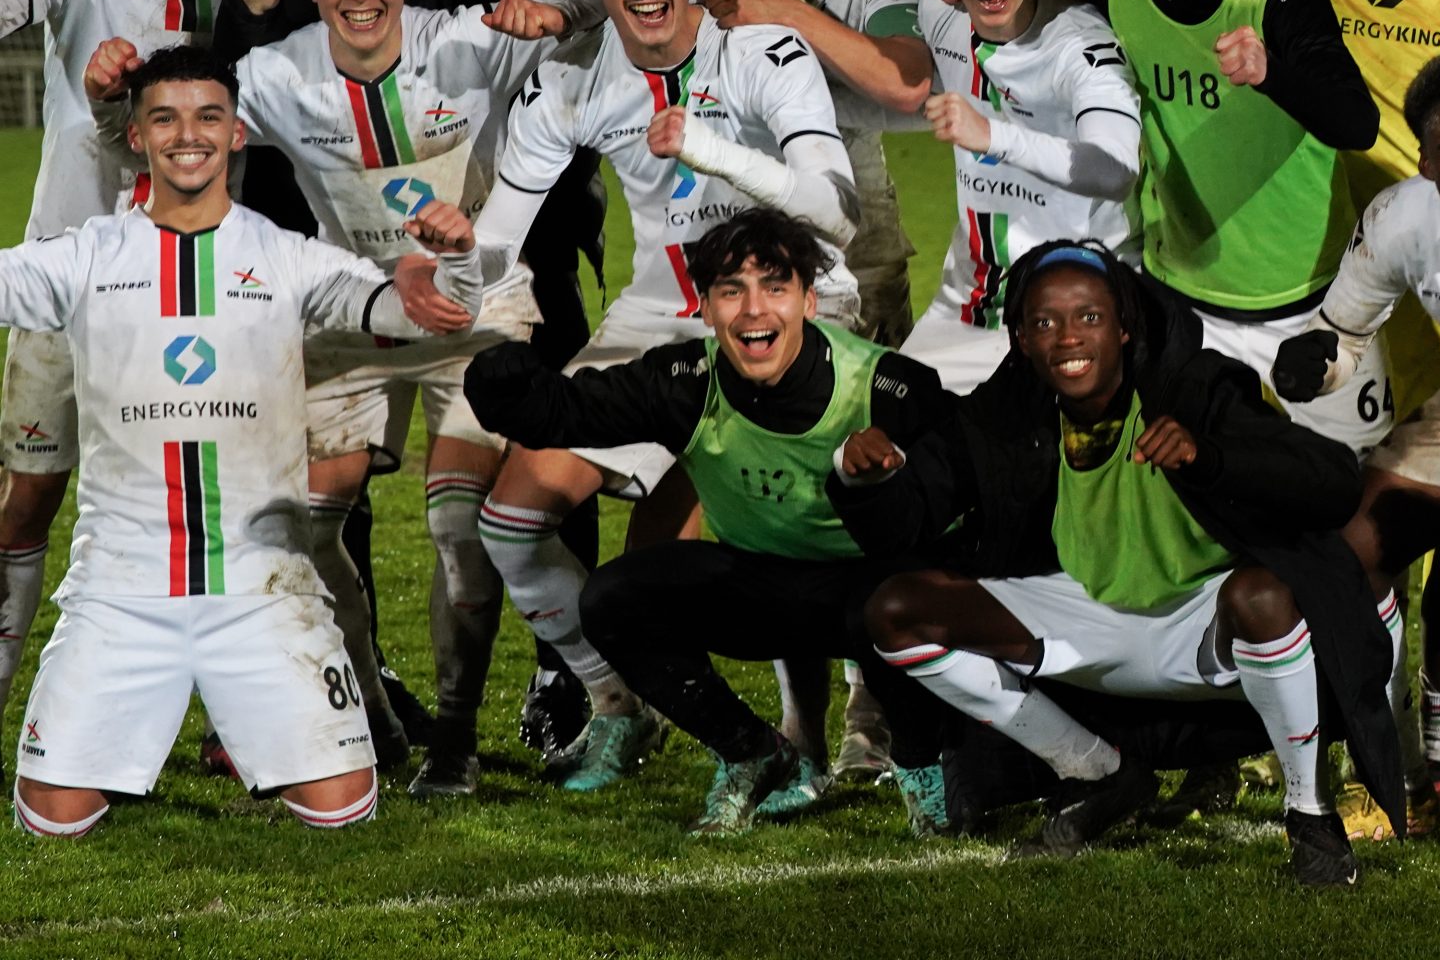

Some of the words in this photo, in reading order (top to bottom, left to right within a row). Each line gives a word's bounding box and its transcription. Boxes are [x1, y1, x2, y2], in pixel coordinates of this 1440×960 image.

[1153, 63, 1221, 110] U18
[424, 127, 438, 140] OH
[439, 117, 469, 138] LEUVEN
[95, 279, 152, 293] STANNO
[242, 290, 273, 302] LEUVEN
[121, 399, 258, 424] ENERGYKING
[323, 664, 360, 711] 80
